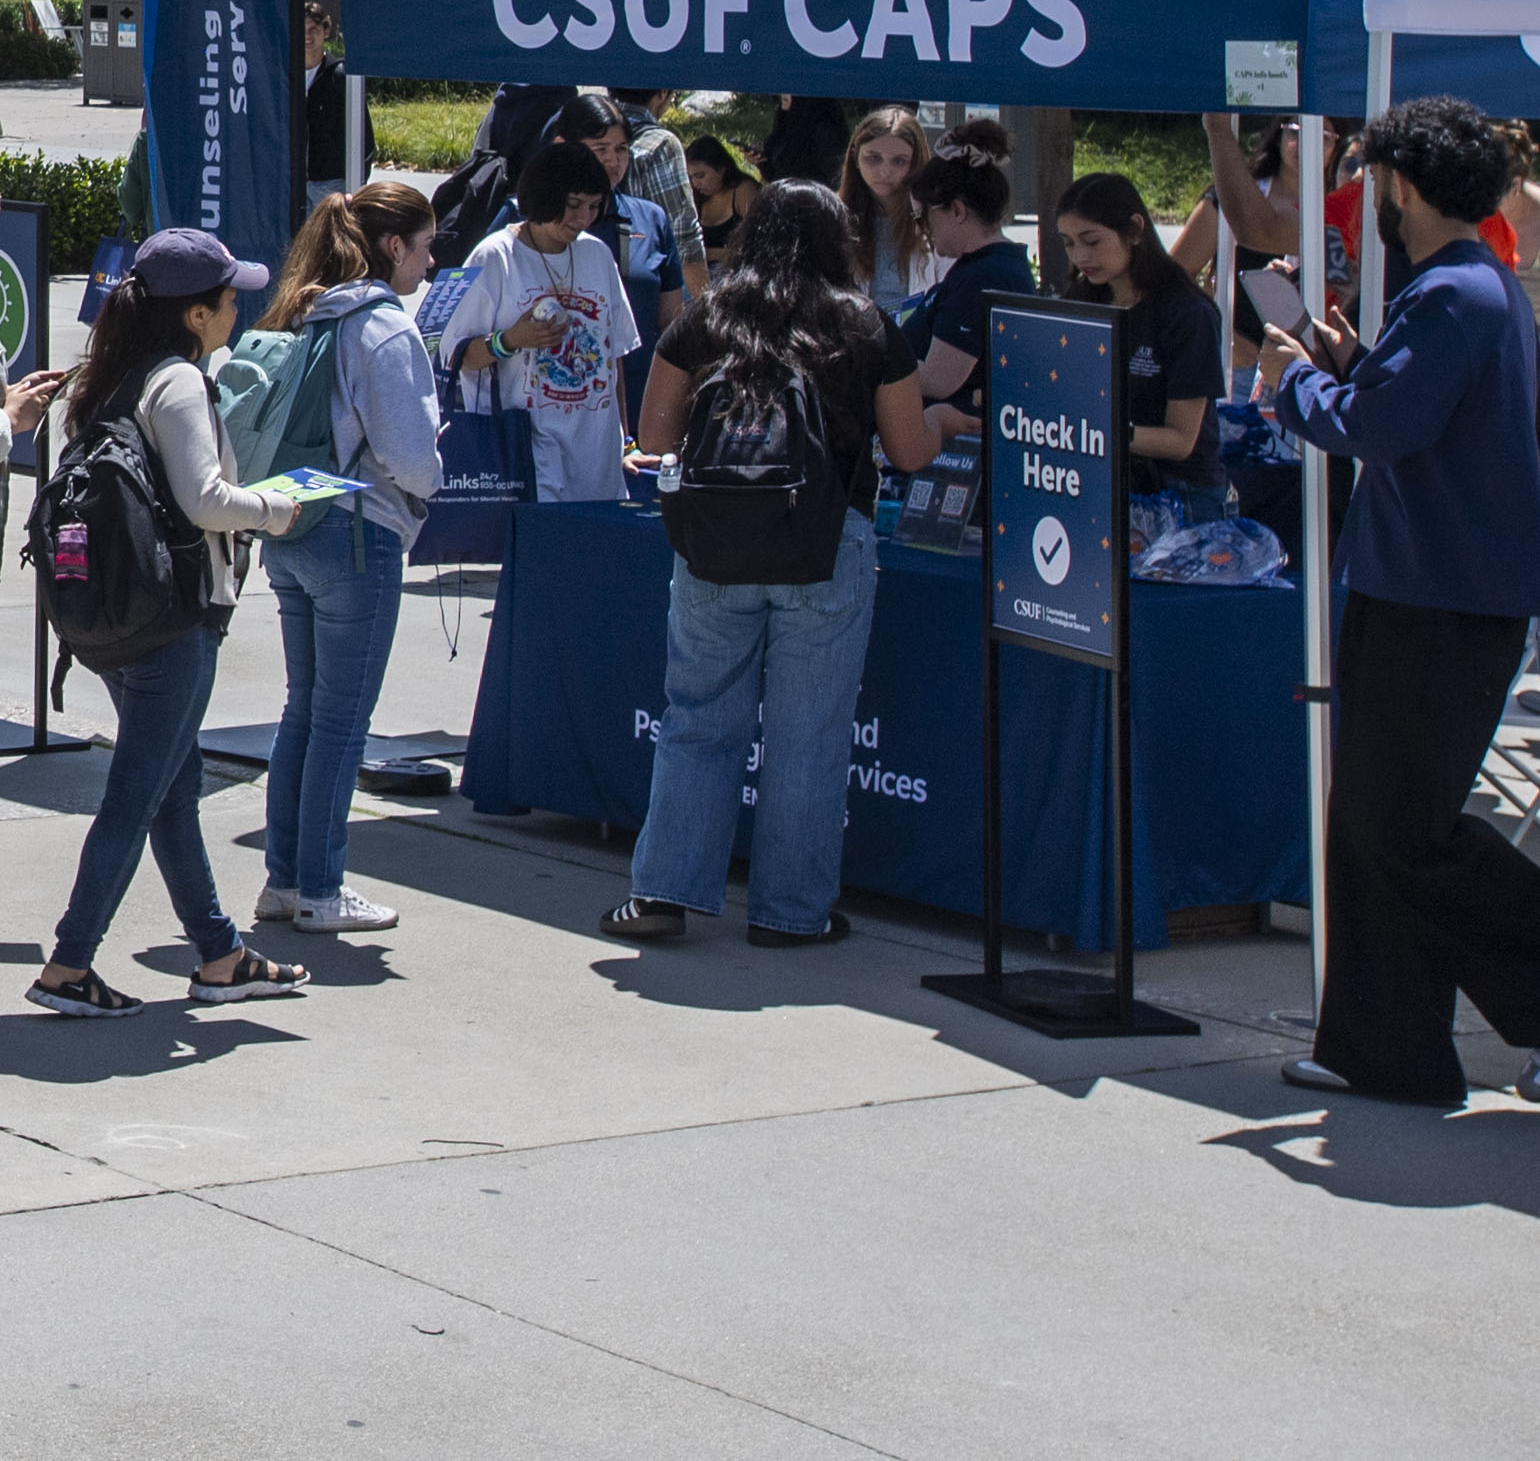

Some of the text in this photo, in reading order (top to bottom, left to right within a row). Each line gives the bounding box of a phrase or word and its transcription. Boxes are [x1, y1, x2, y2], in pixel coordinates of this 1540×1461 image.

[198, 9, 222, 236] unseling
[106, 275, 121, 285] Lin
[999, 404, 1105, 457] Check In
[933, 453, 960, 467] ollow
[1022, 451, 1081, 497] Here
[1014, 599, 1041, 620] CSUF
[852, 717, 879, 749] nd
[847, 761, 928, 803] rvices
